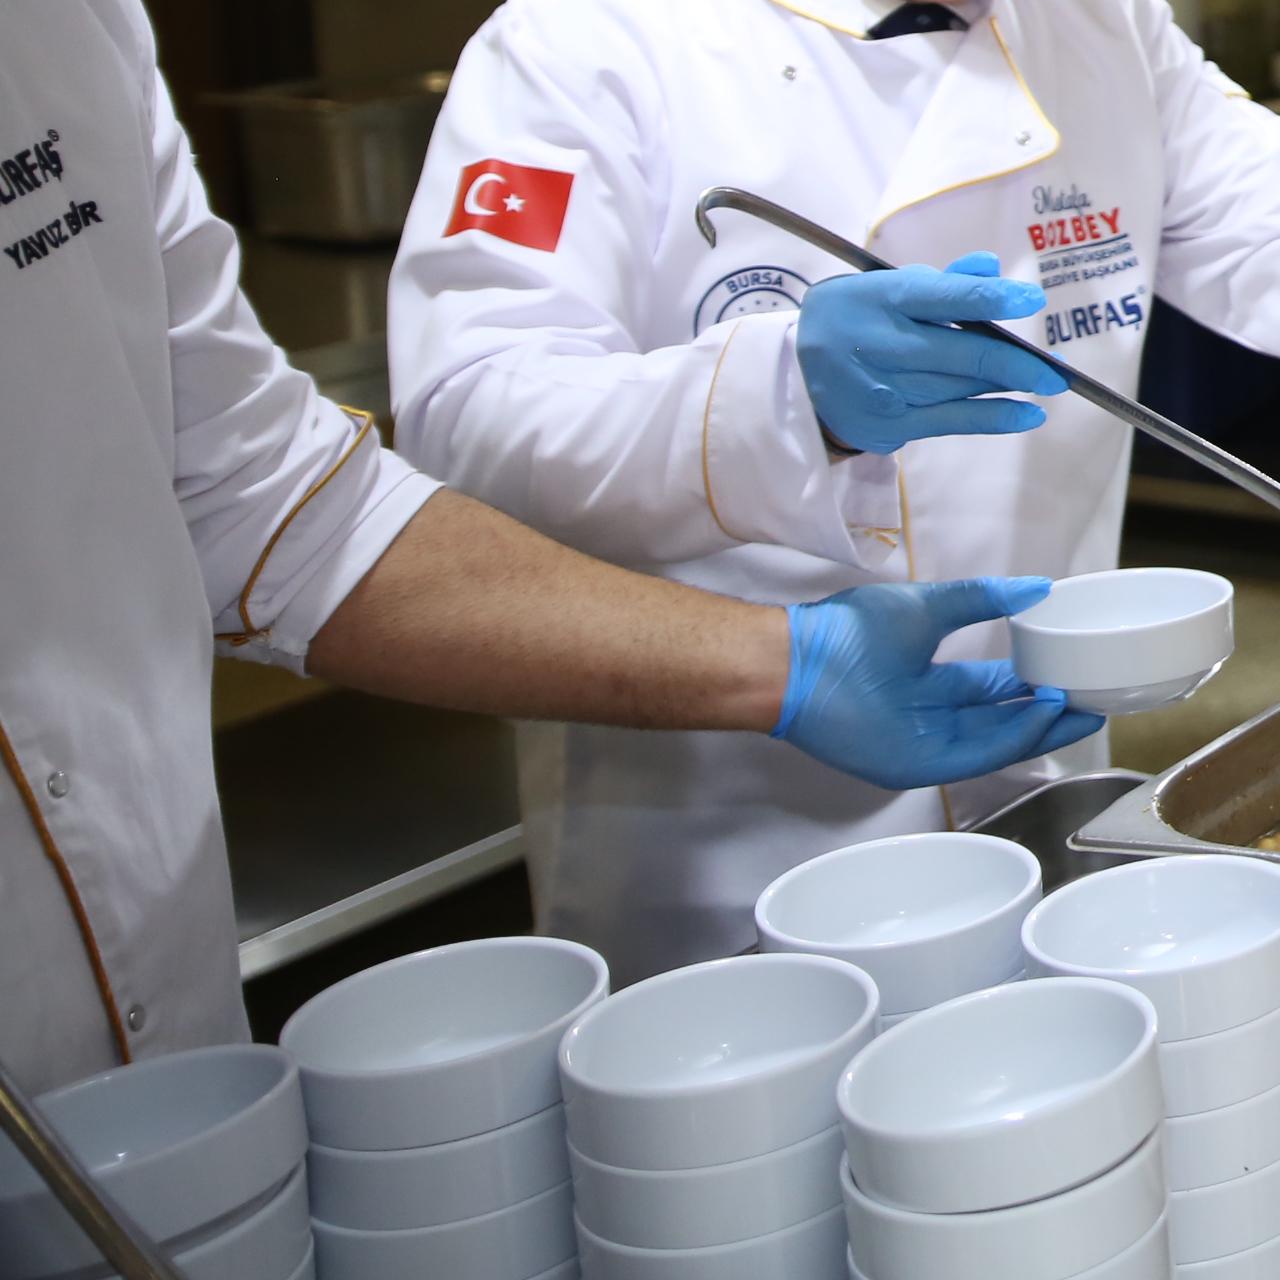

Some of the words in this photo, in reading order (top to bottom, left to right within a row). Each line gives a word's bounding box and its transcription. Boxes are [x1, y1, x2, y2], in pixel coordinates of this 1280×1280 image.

[0, 140, 63, 207] URFAŞ
[3, 218, 70, 270] YAVUZ
[1027, 206, 1121, 252] BOZBEY
[726, 271, 784, 294] BURSA
[1045, 293, 1143, 346] BURFAŞ
